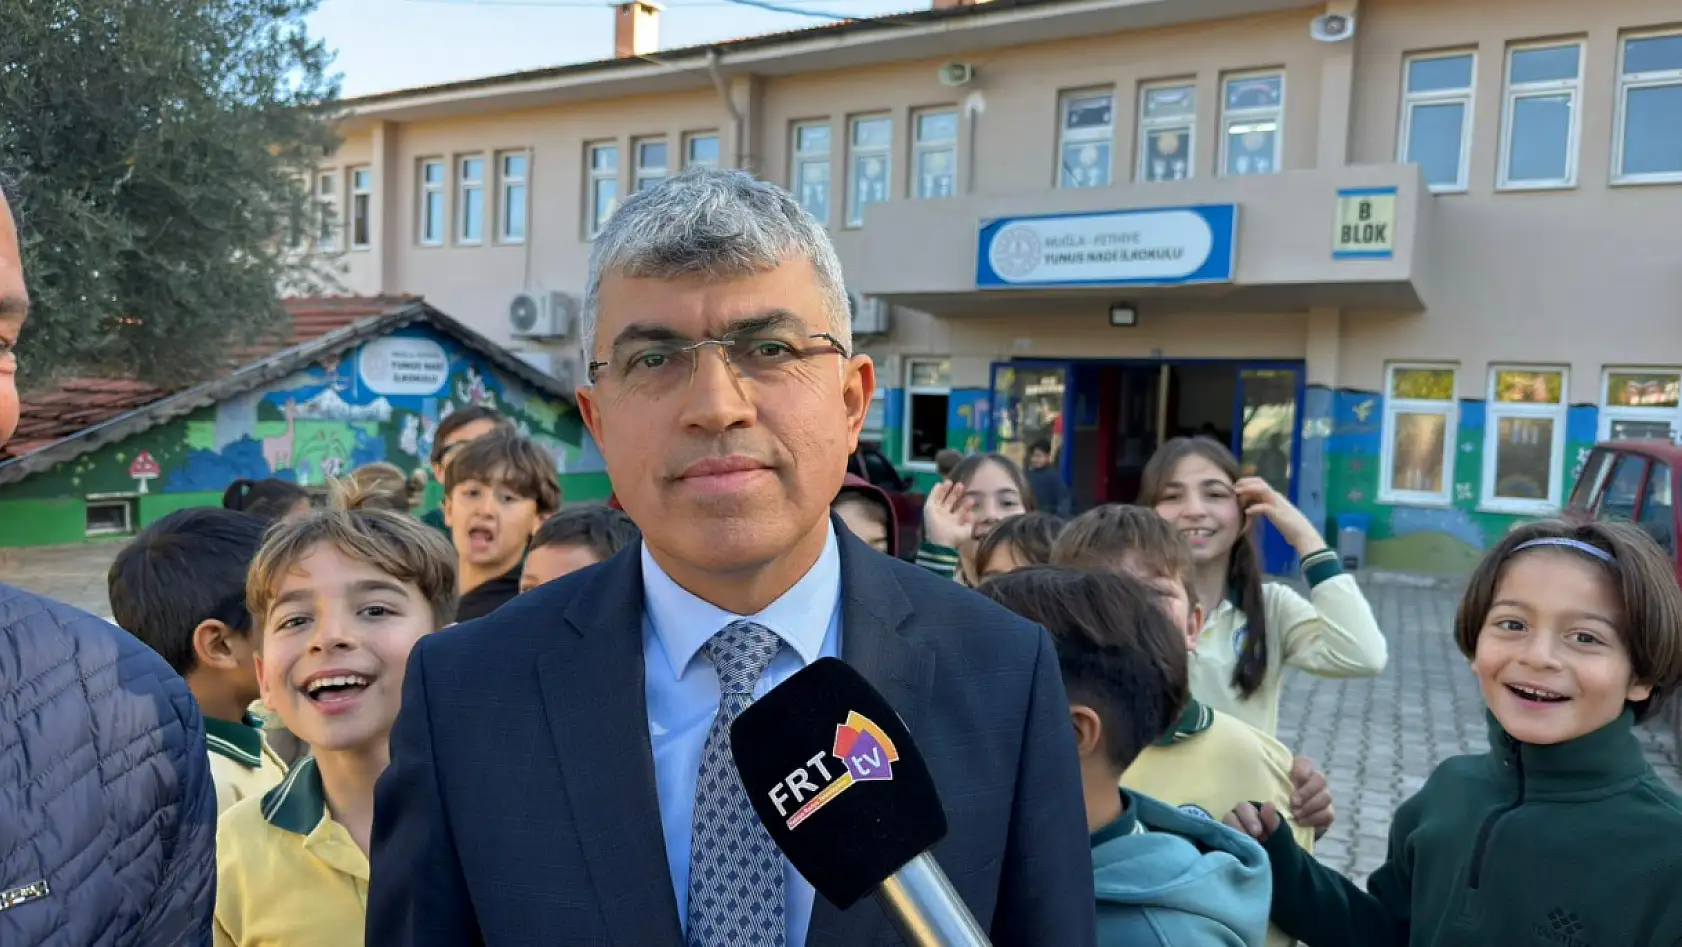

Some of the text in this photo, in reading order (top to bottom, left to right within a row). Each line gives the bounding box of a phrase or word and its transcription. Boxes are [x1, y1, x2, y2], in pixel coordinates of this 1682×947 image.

[1358, 202, 1371, 221] B
[1341, 224, 1388, 244] BLOK
[767, 750, 833, 817] FRT
[851, 746, 881, 776] tv
